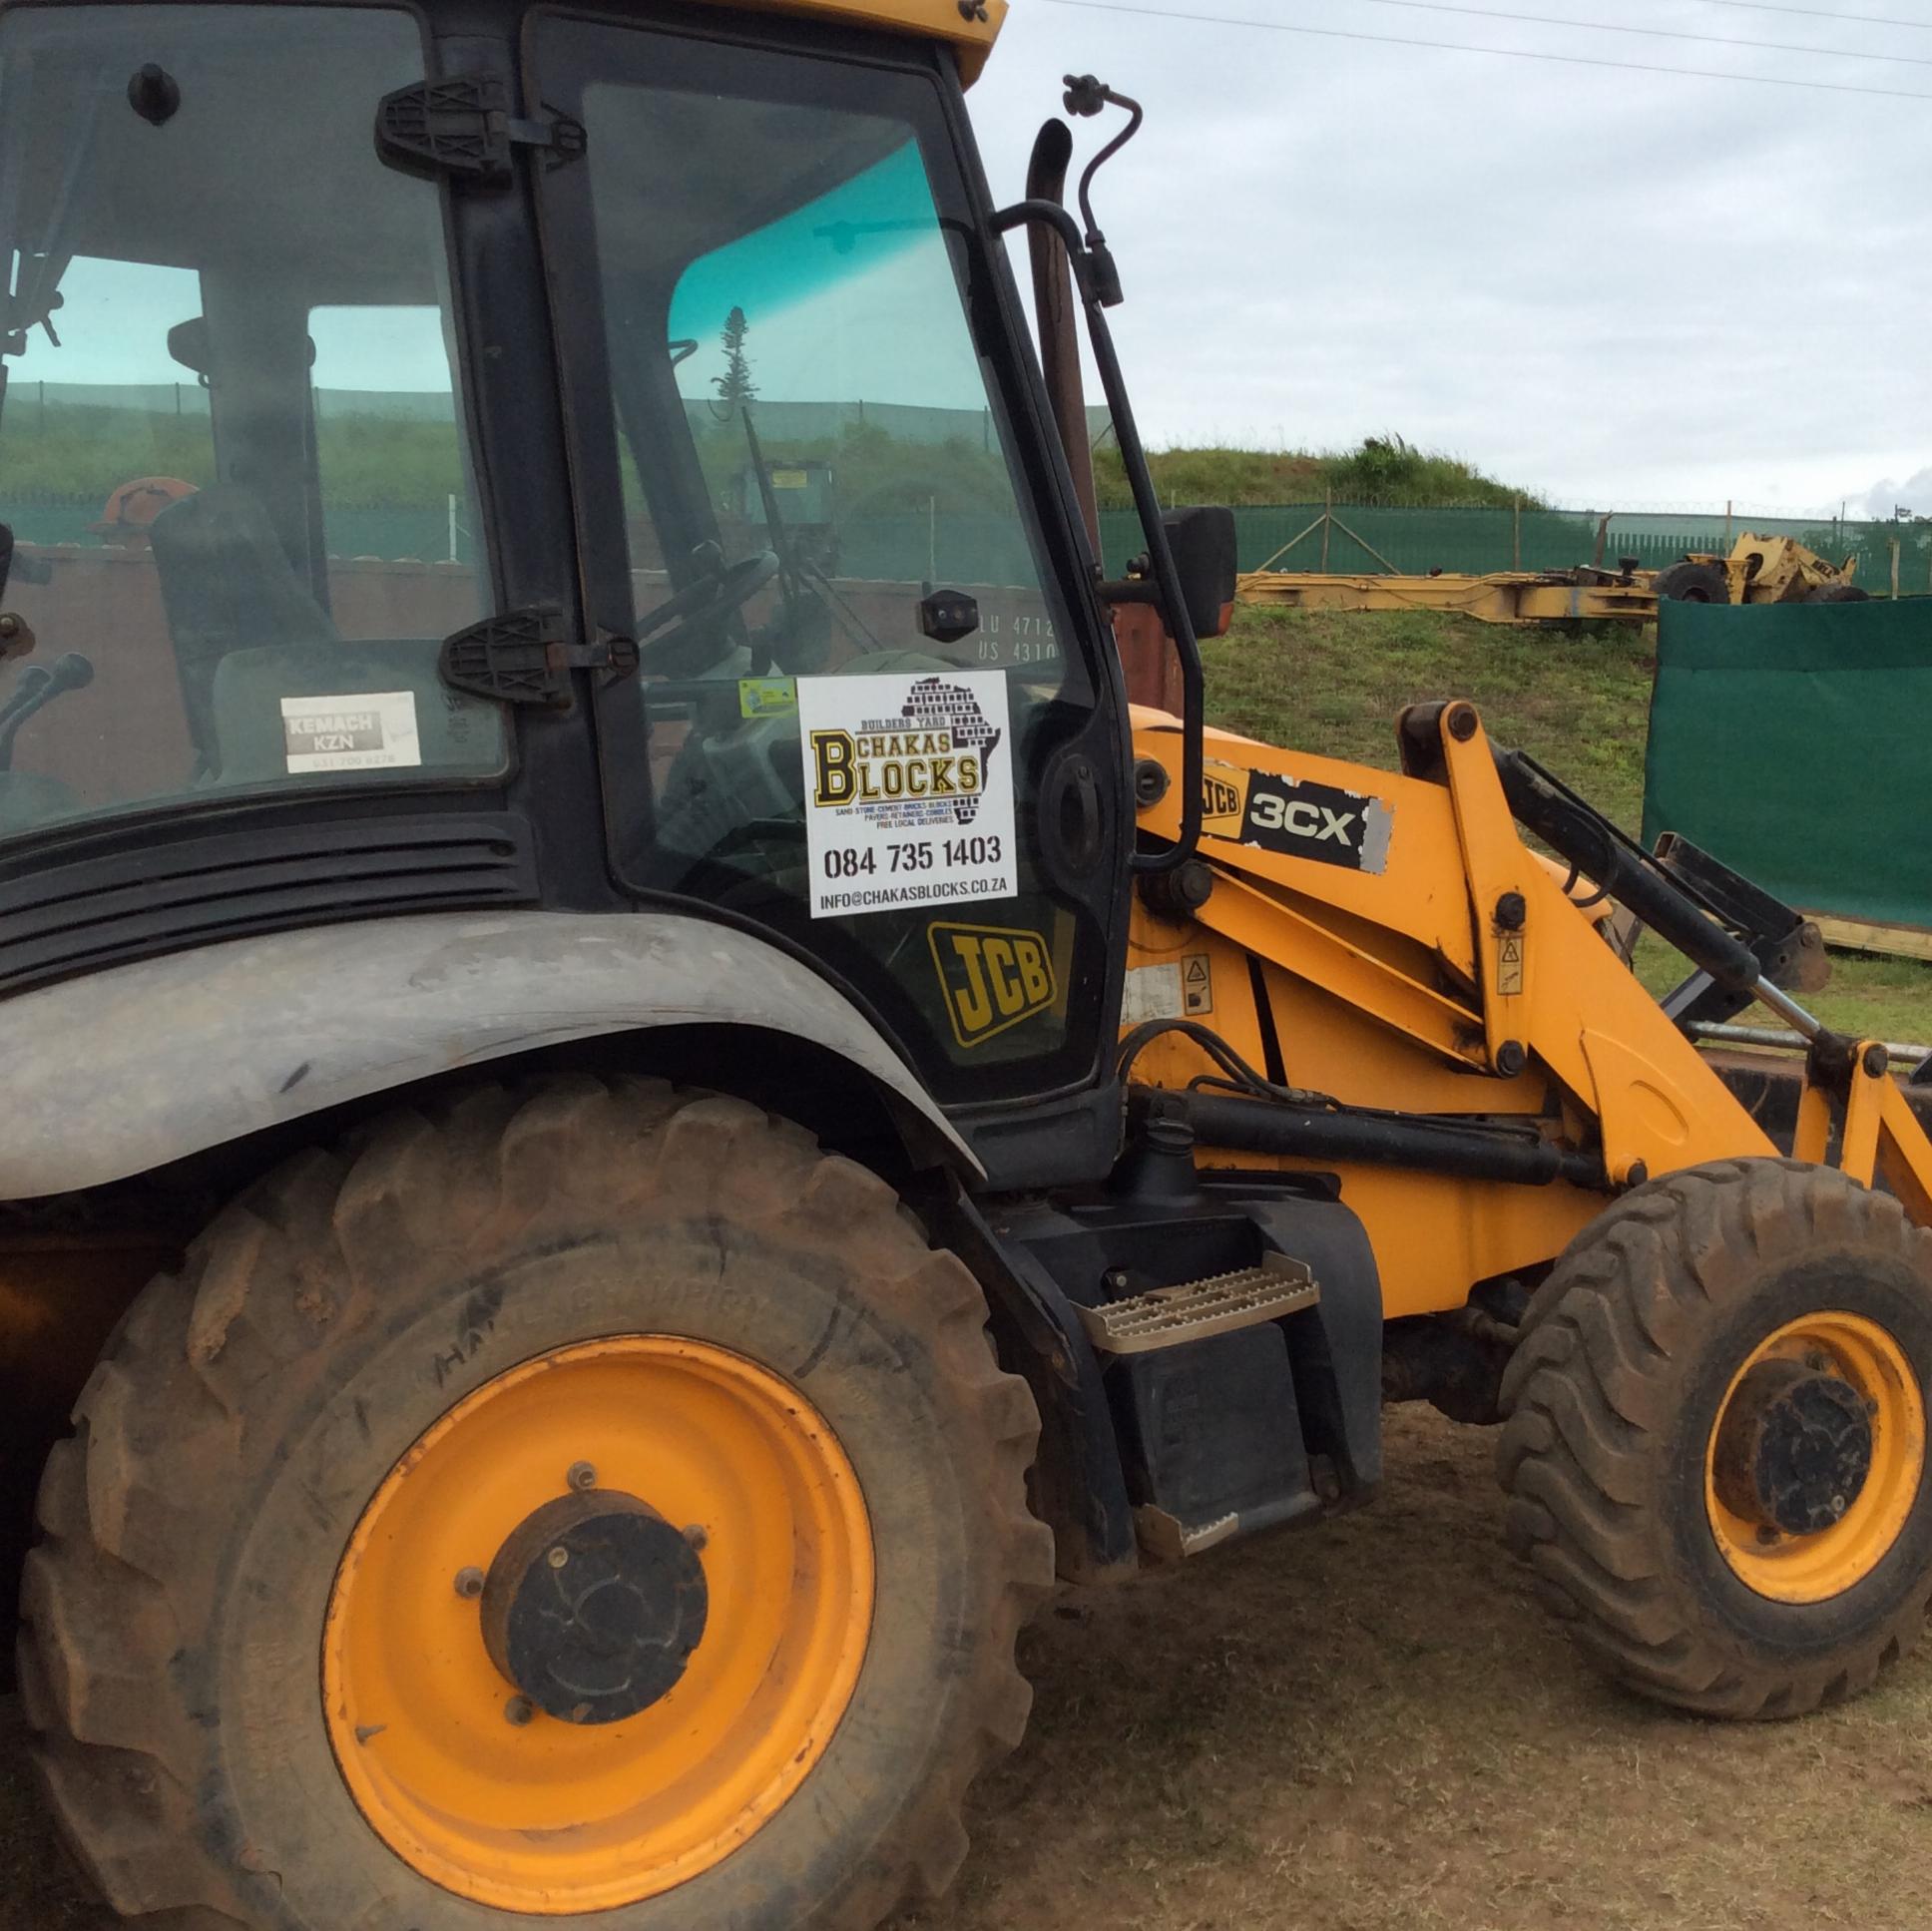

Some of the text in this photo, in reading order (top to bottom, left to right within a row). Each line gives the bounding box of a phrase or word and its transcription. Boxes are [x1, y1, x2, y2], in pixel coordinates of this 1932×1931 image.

[979, 641, 999, 661] US
[288, 713, 373, 734] KEMACH
[861, 716, 946, 730] BUILDERS YARD
[313, 733, 354, 751] KZN
[856, 732, 951, 758] CHAKAS
[894, 818, 915, 828] LOCAL
[1203, 778, 1355, 846] JCB 3CX
[823, 835, 1002, 879] 084 735 1403
[820, 877, 1008, 910] INFO@CHAKASBLOCKS.CO.ZA
[951, 935, 1049, 1032] JCB
